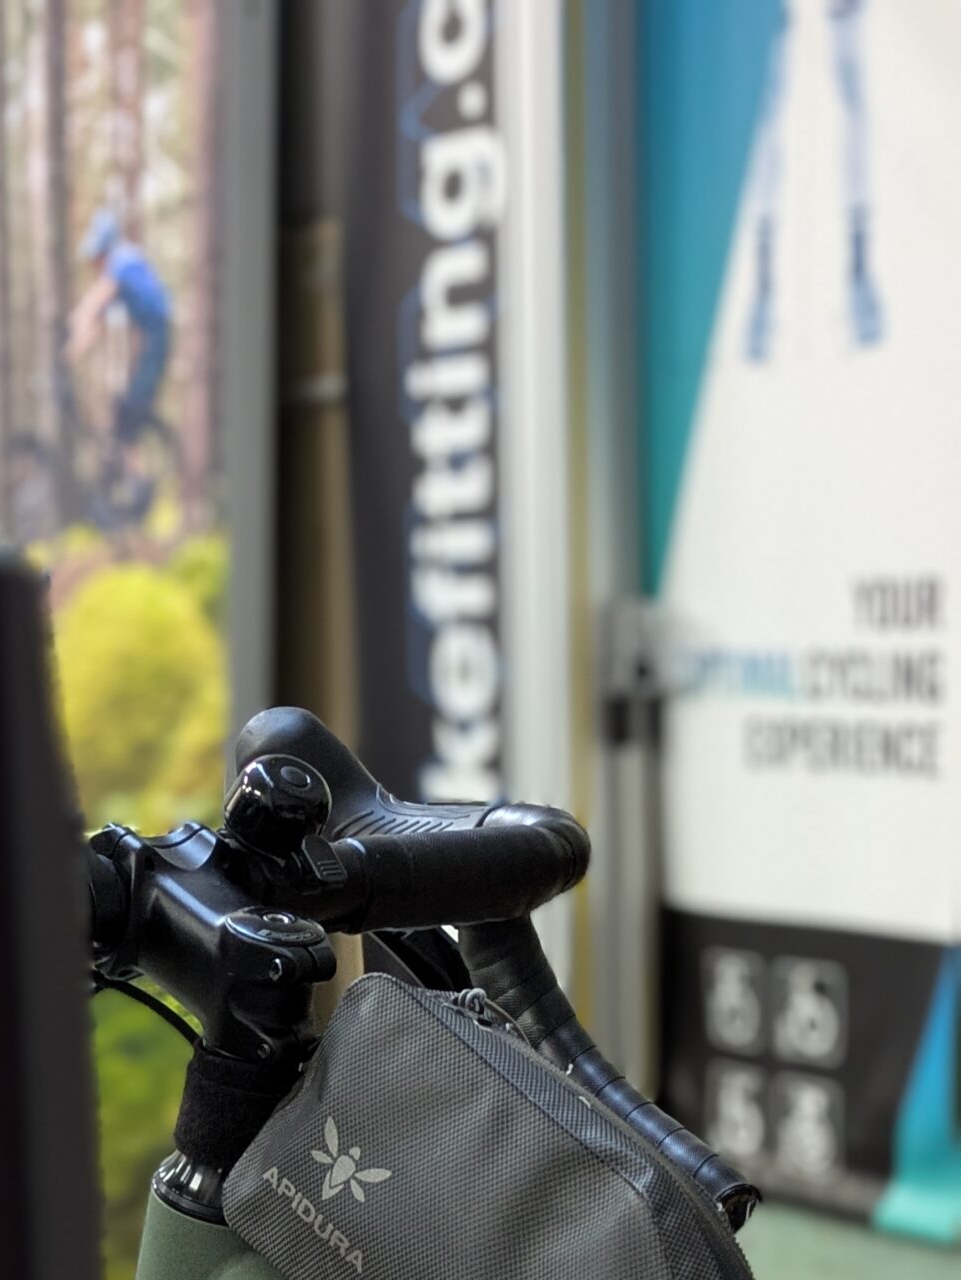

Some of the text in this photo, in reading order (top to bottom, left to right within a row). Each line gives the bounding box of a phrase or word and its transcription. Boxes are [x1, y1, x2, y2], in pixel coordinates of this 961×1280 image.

[850, 576, 944, 634] YOUR
[806, 648, 944, 706] CYCLING
[742, 714, 944, 778] EXPERIENCE
[262, 1166, 363, 1273] APIDURA
